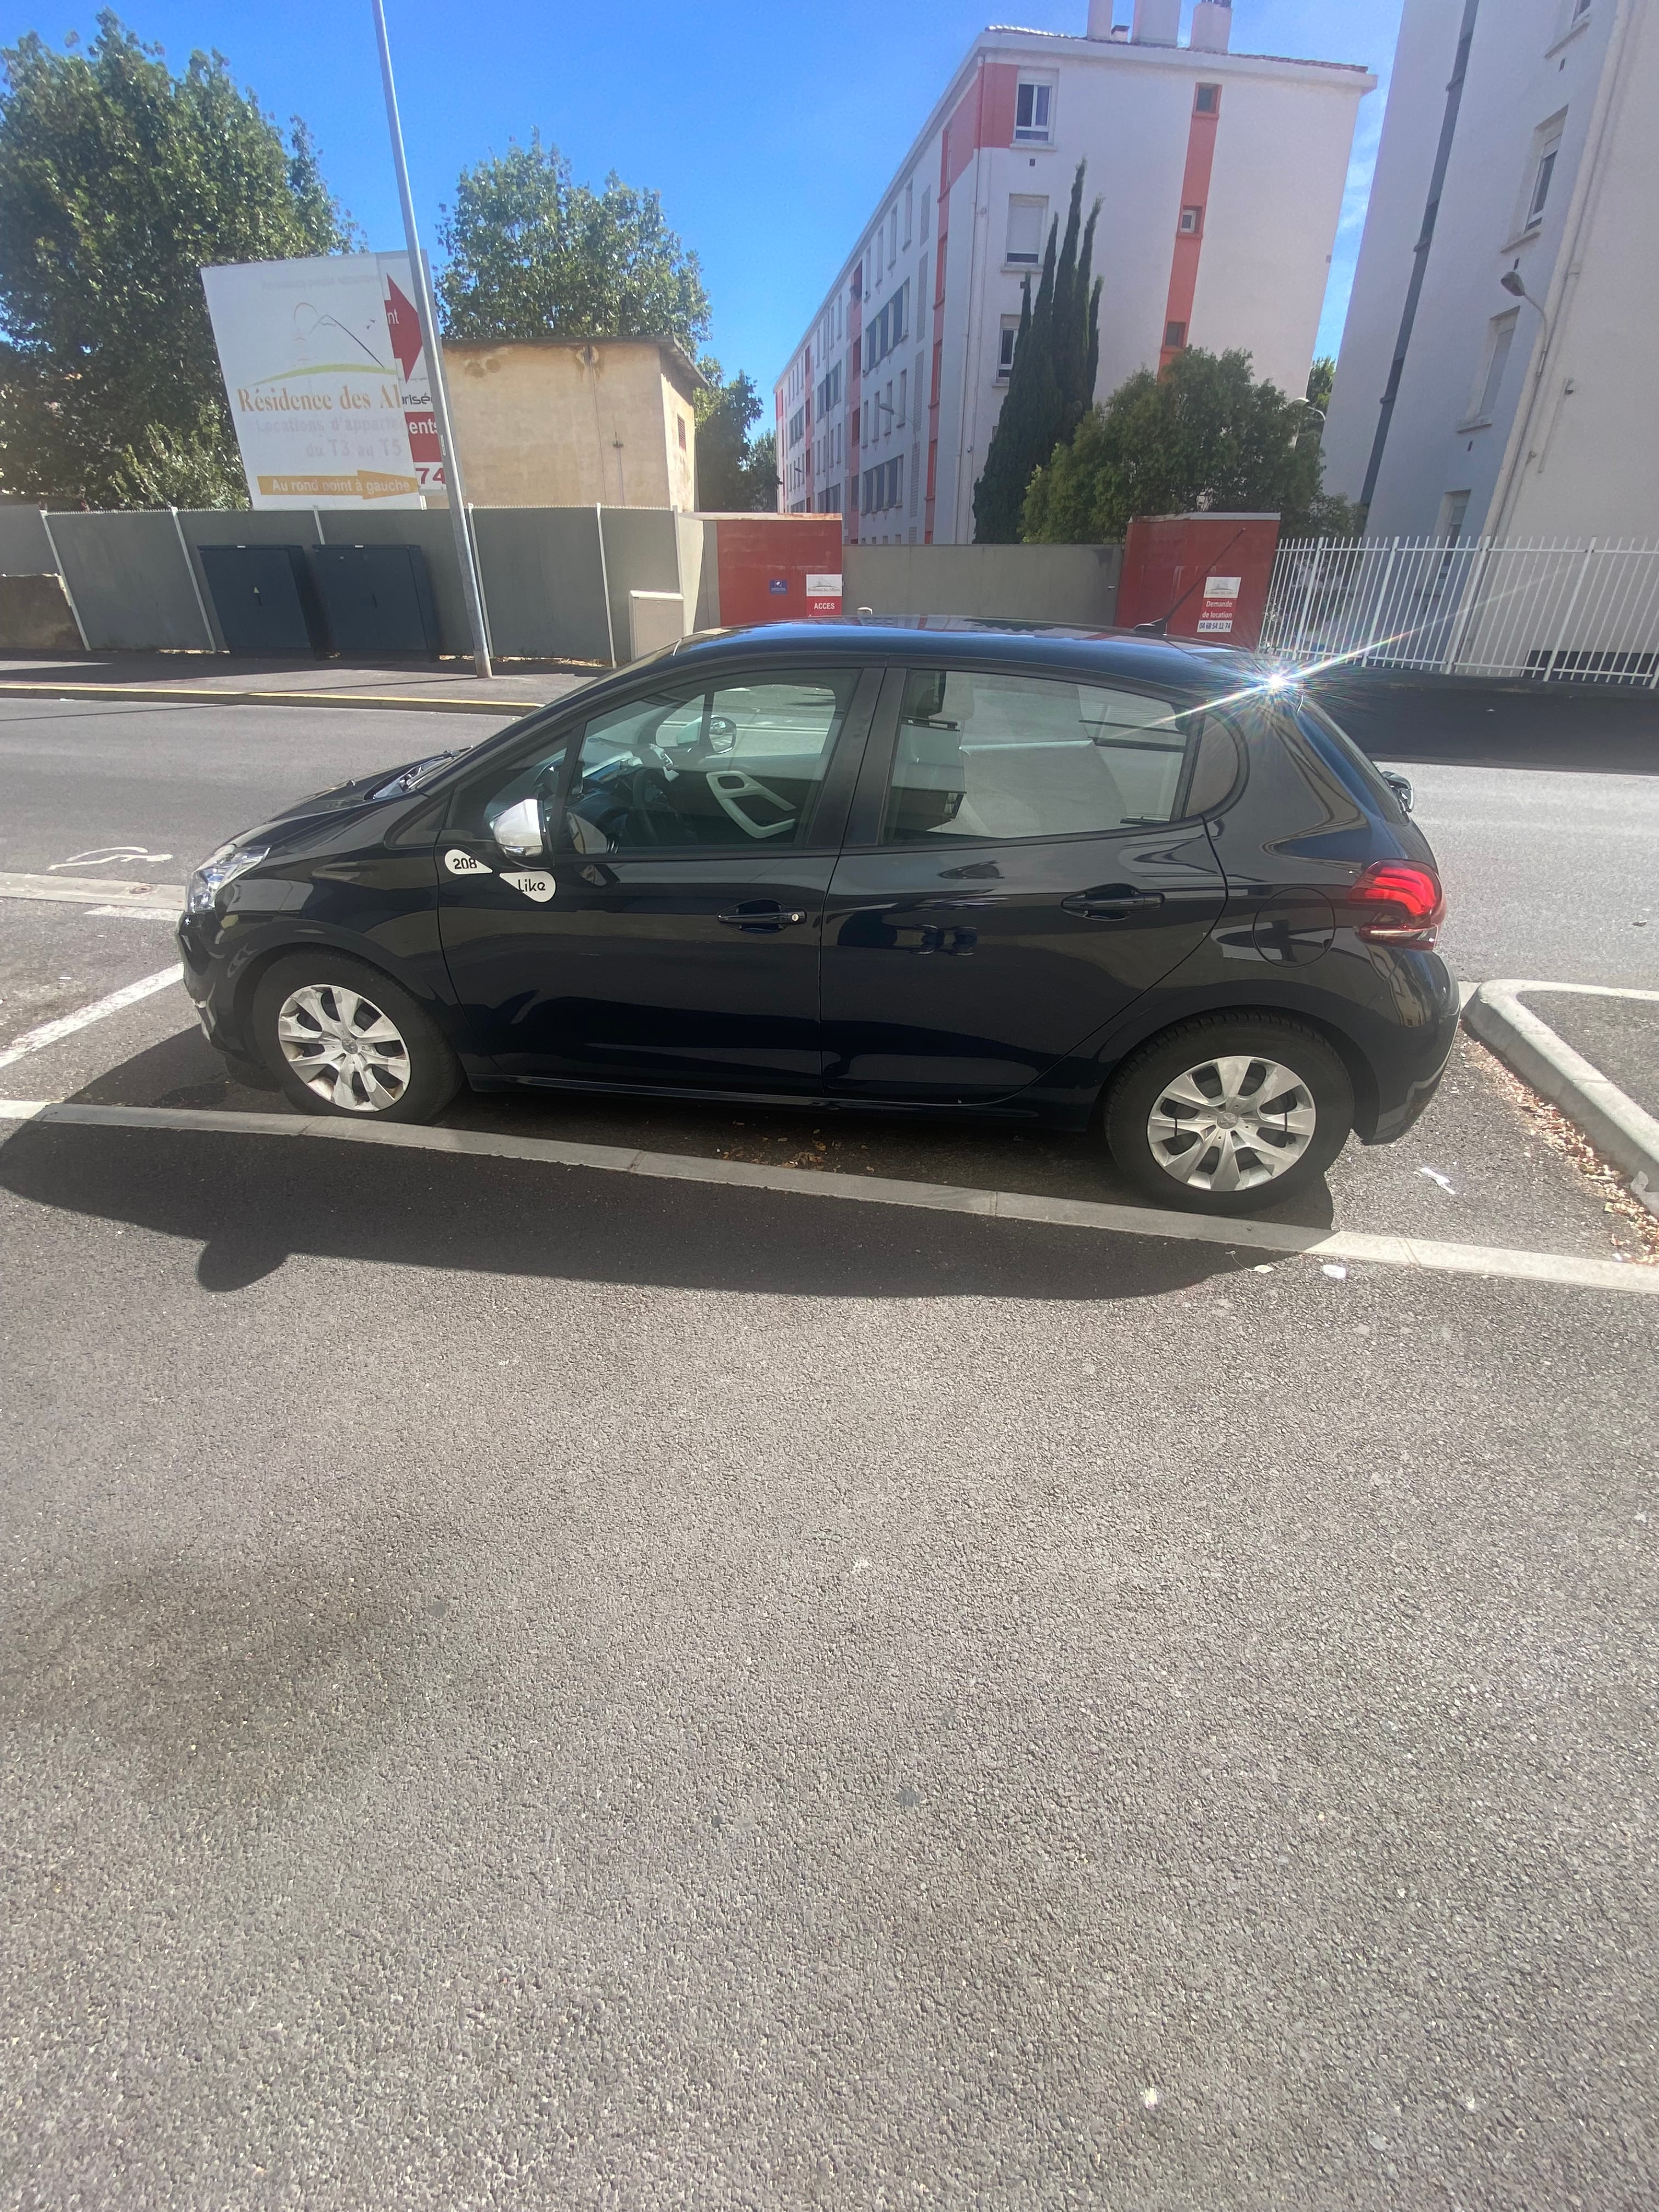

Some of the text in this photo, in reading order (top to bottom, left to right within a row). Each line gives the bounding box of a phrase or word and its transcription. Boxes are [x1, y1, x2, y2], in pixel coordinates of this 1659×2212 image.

[237, 387, 333, 412] Résidence
[339, 385, 371, 410] des
[256, 417, 325, 432] Locations
[306, 438, 402, 457] du T3 au T5
[415, 467, 446, 484] 74
[273, 479, 410, 494] Au rond point à gauche
[453, 857, 477, 869] 208
[518, 879, 546, 892] Like
